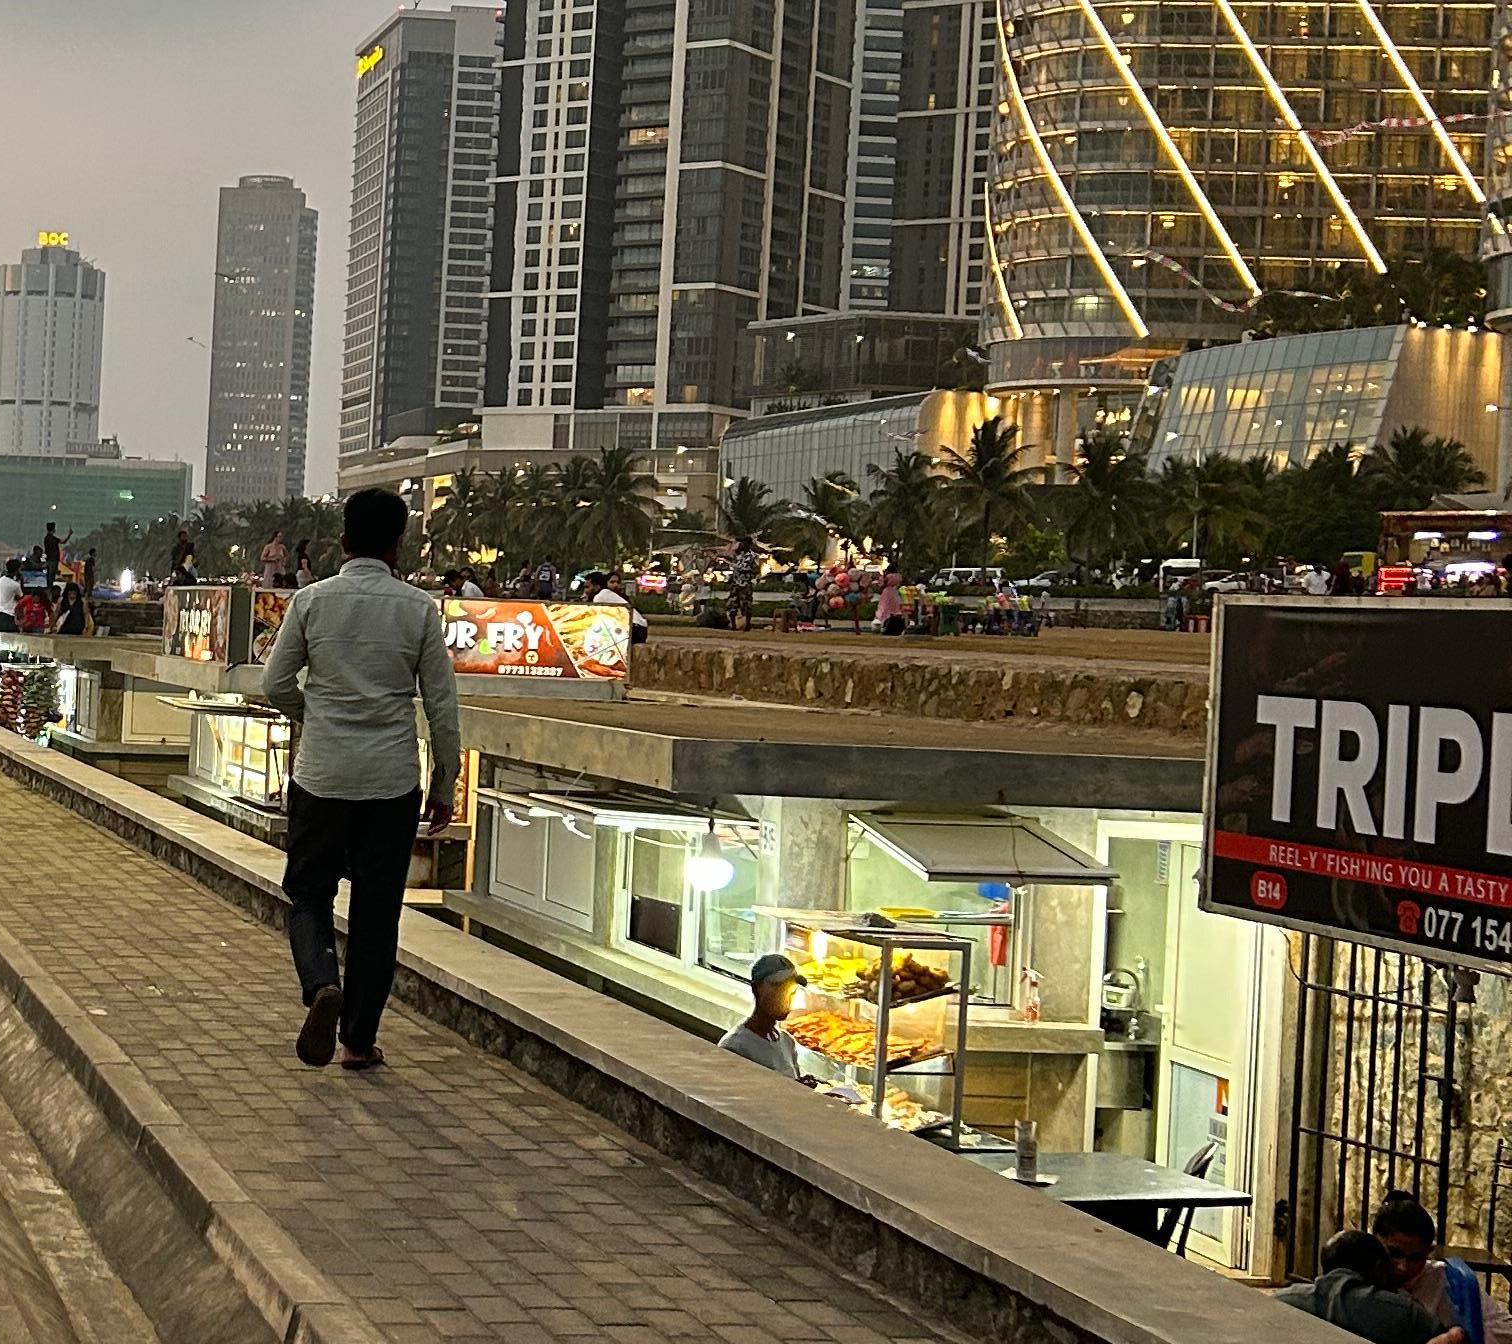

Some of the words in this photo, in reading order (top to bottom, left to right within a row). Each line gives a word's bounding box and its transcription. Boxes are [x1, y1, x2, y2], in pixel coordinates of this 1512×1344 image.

[487, 621, 544, 651] FRY
[1257, 879, 1281, 901] B14
[1269, 844, 1318, 869] REEL-Y
[1398, 864, 1432, 889] YOU
[1438, 872, 1450, 893] A
[1455, 874, 1510, 903] TASTY
[1424, 906, 1464, 943] 077
